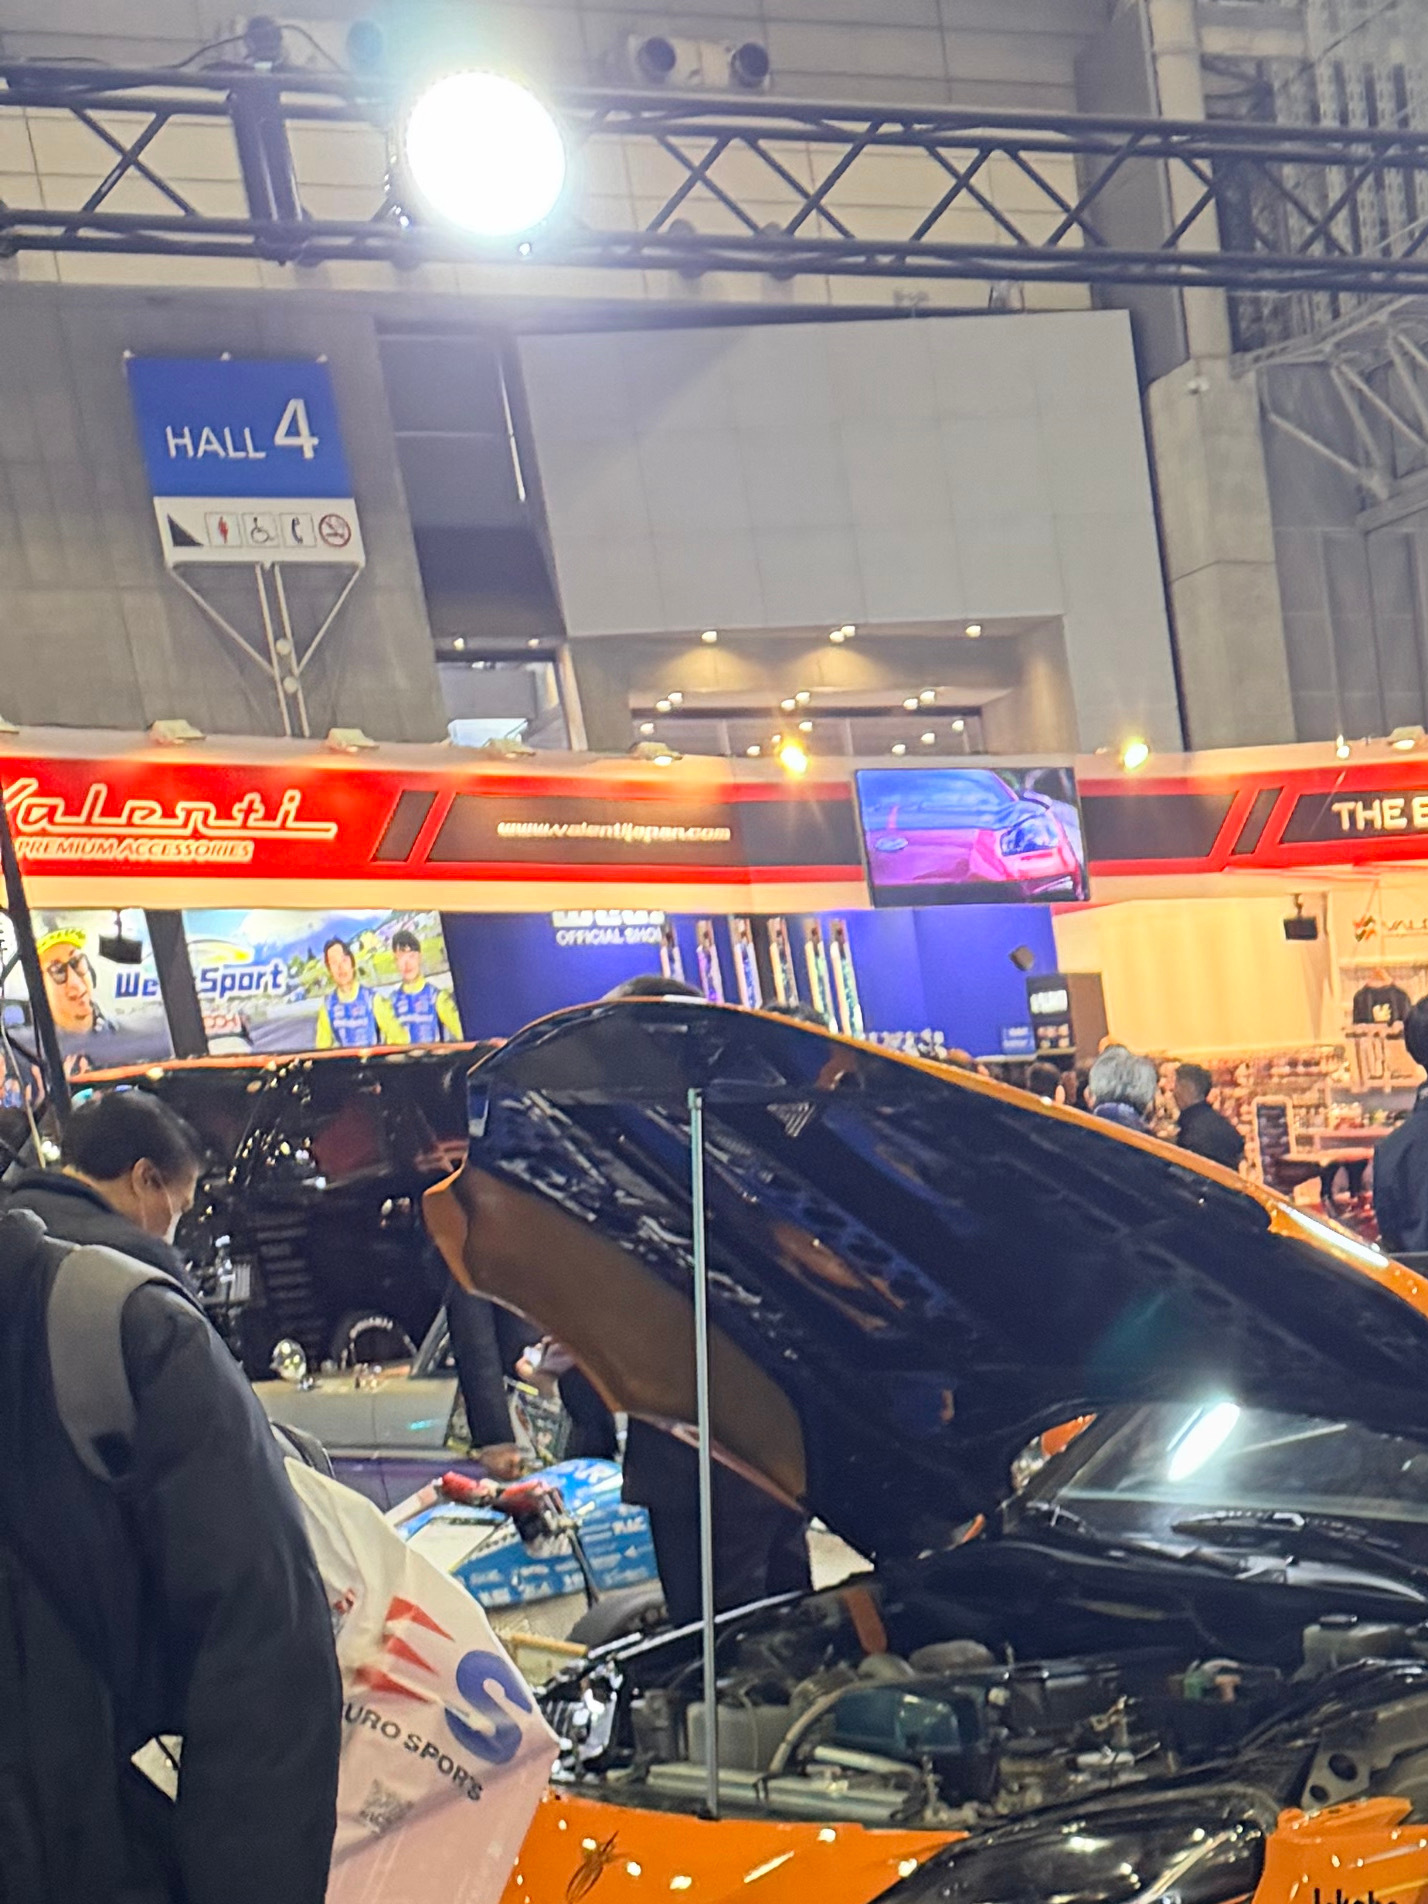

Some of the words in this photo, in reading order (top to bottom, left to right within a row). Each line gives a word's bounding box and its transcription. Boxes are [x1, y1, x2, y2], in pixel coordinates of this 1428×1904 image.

[165, 425, 266, 459] HALL
[273, 398, 319, 459] 4
[1333, 799, 1407, 832] THE
[16, 837, 117, 861] PREMIUM
[119, 838, 254, 862] ACCESSORIES
[556, 927, 622, 947] OFFICIAL
[199, 963, 283, 994] Sport
